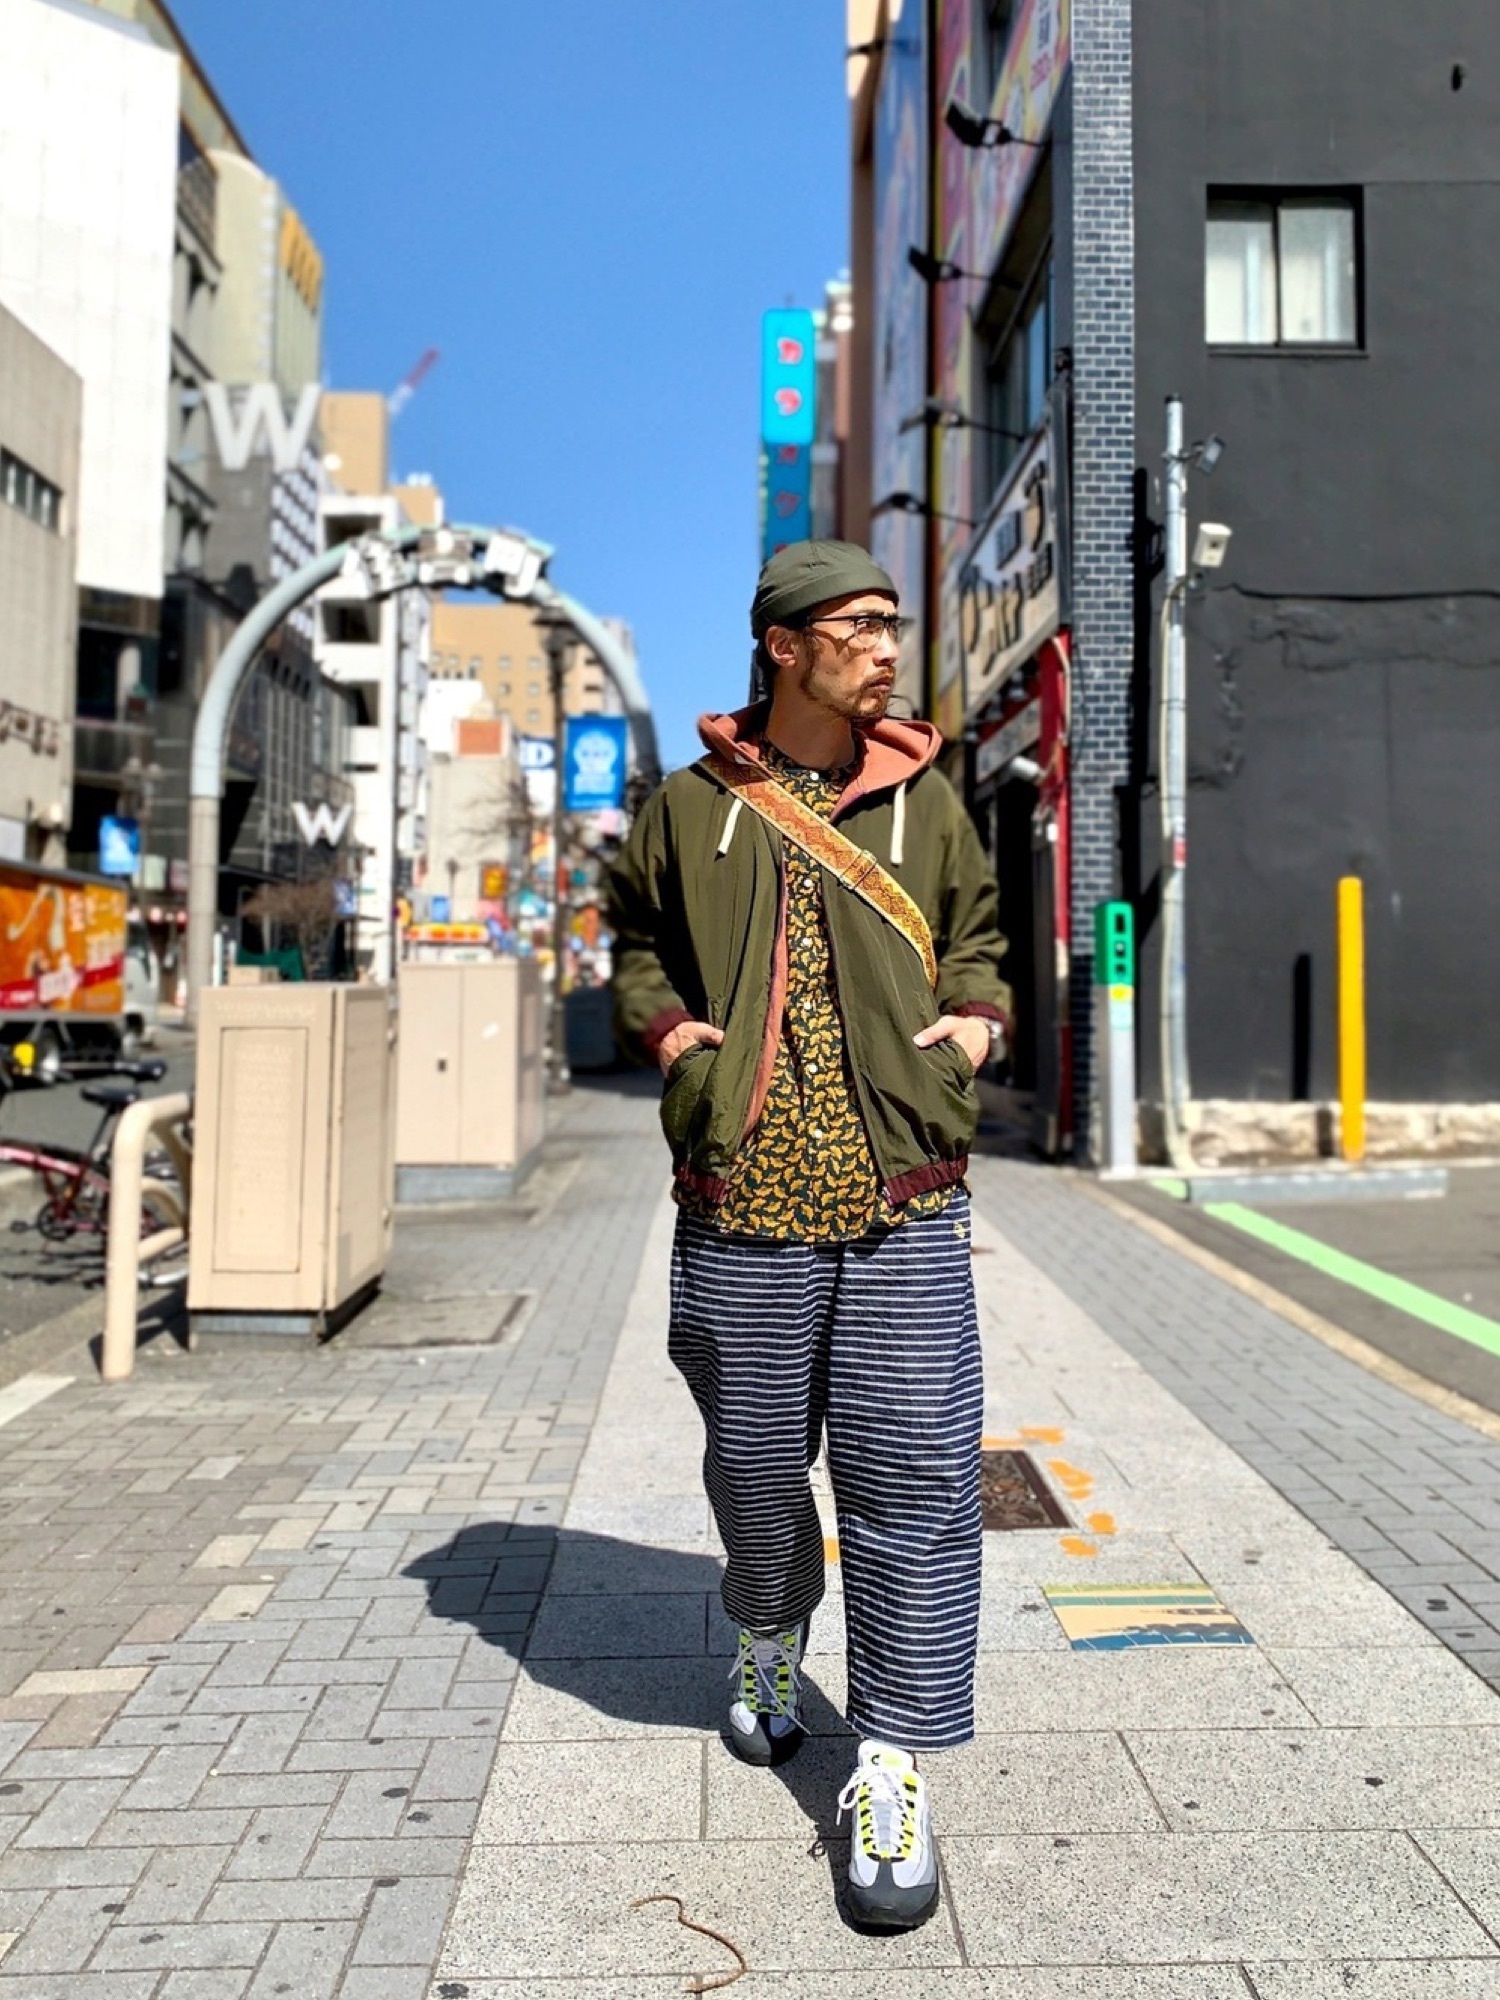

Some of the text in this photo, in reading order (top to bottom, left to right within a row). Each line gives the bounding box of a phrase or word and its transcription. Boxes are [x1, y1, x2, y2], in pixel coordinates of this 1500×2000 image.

[204, 382, 321, 470] W
[775, 337, 803, 553] カラオケ
[292, 802, 352, 847] W
